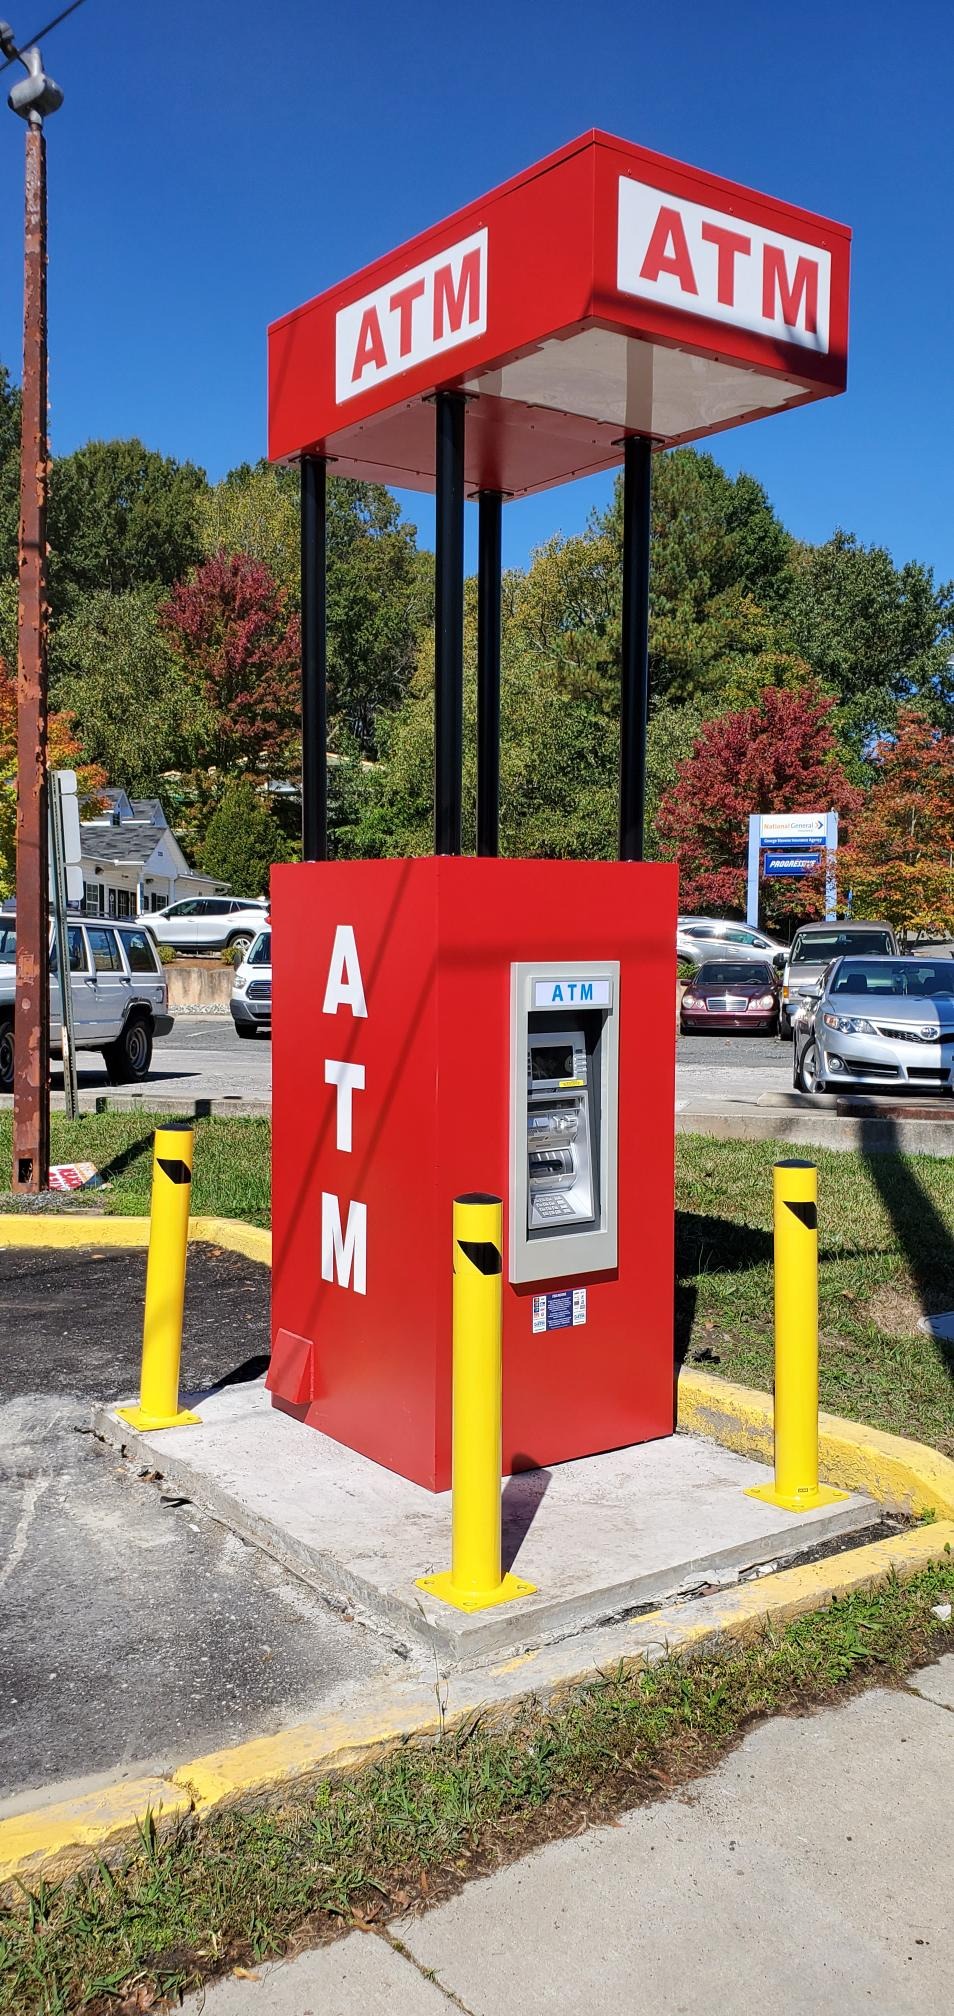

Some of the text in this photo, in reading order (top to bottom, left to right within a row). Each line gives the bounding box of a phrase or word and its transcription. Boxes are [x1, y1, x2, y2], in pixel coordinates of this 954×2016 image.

[350, 245, 482, 384] ATM
[639, 205, 820, 335] ATM
[551, 983, 594, 1002] ATM
[321, 924, 369, 1296] ATM
